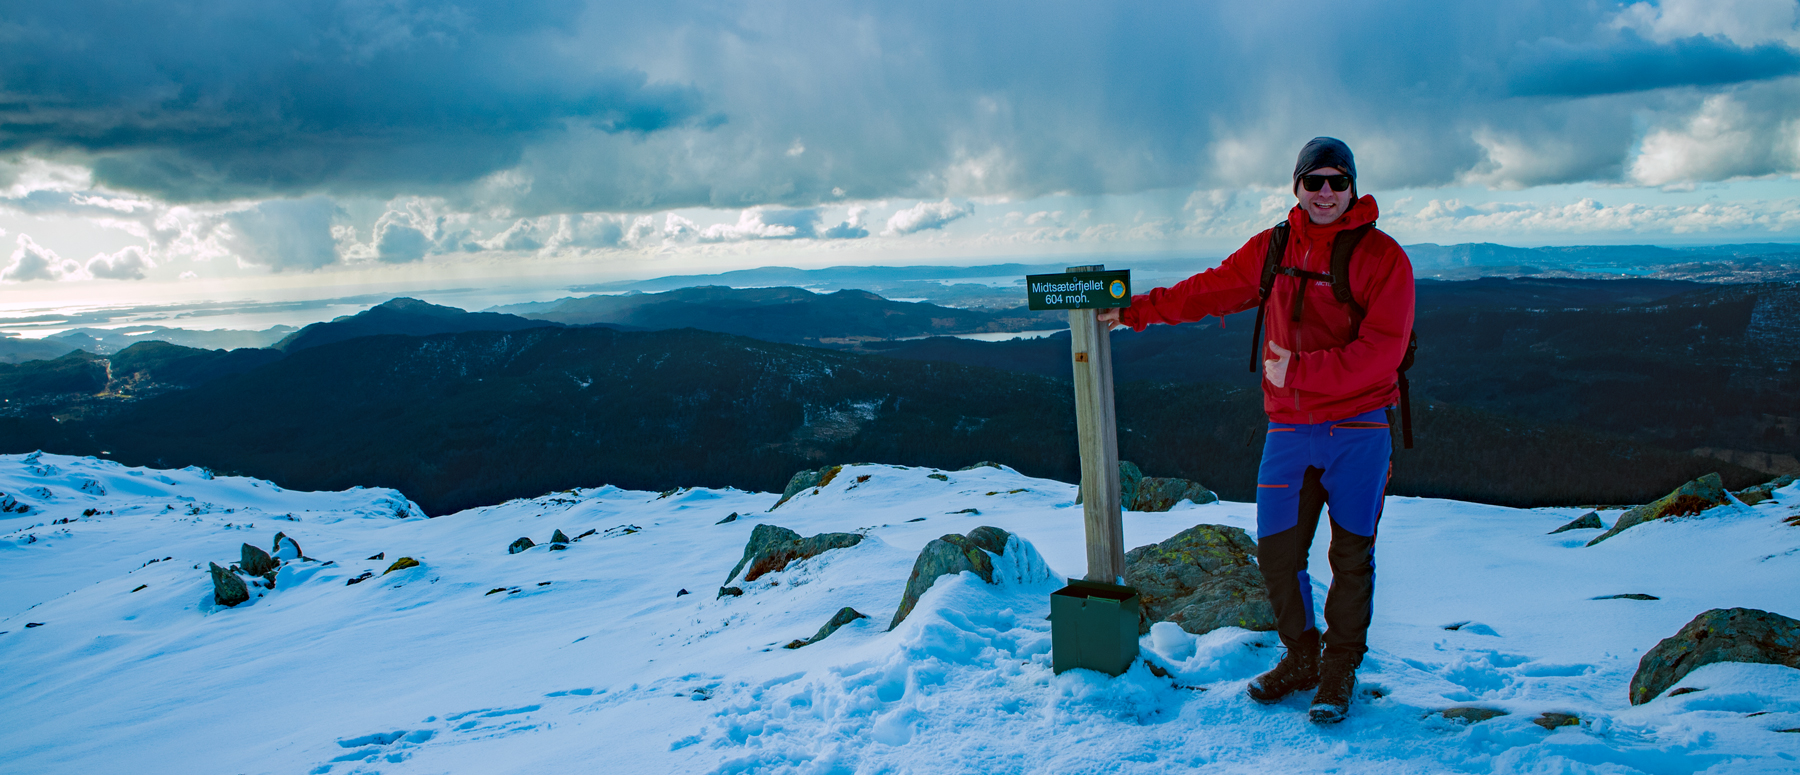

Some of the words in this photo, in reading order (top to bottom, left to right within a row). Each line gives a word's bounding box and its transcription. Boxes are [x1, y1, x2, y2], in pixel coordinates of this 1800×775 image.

[1032, 280, 1104, 293] Midtsæterfjellet
[1045, 294, 1063, 304] 604
[1065, 293, 1090, 303] moh.
